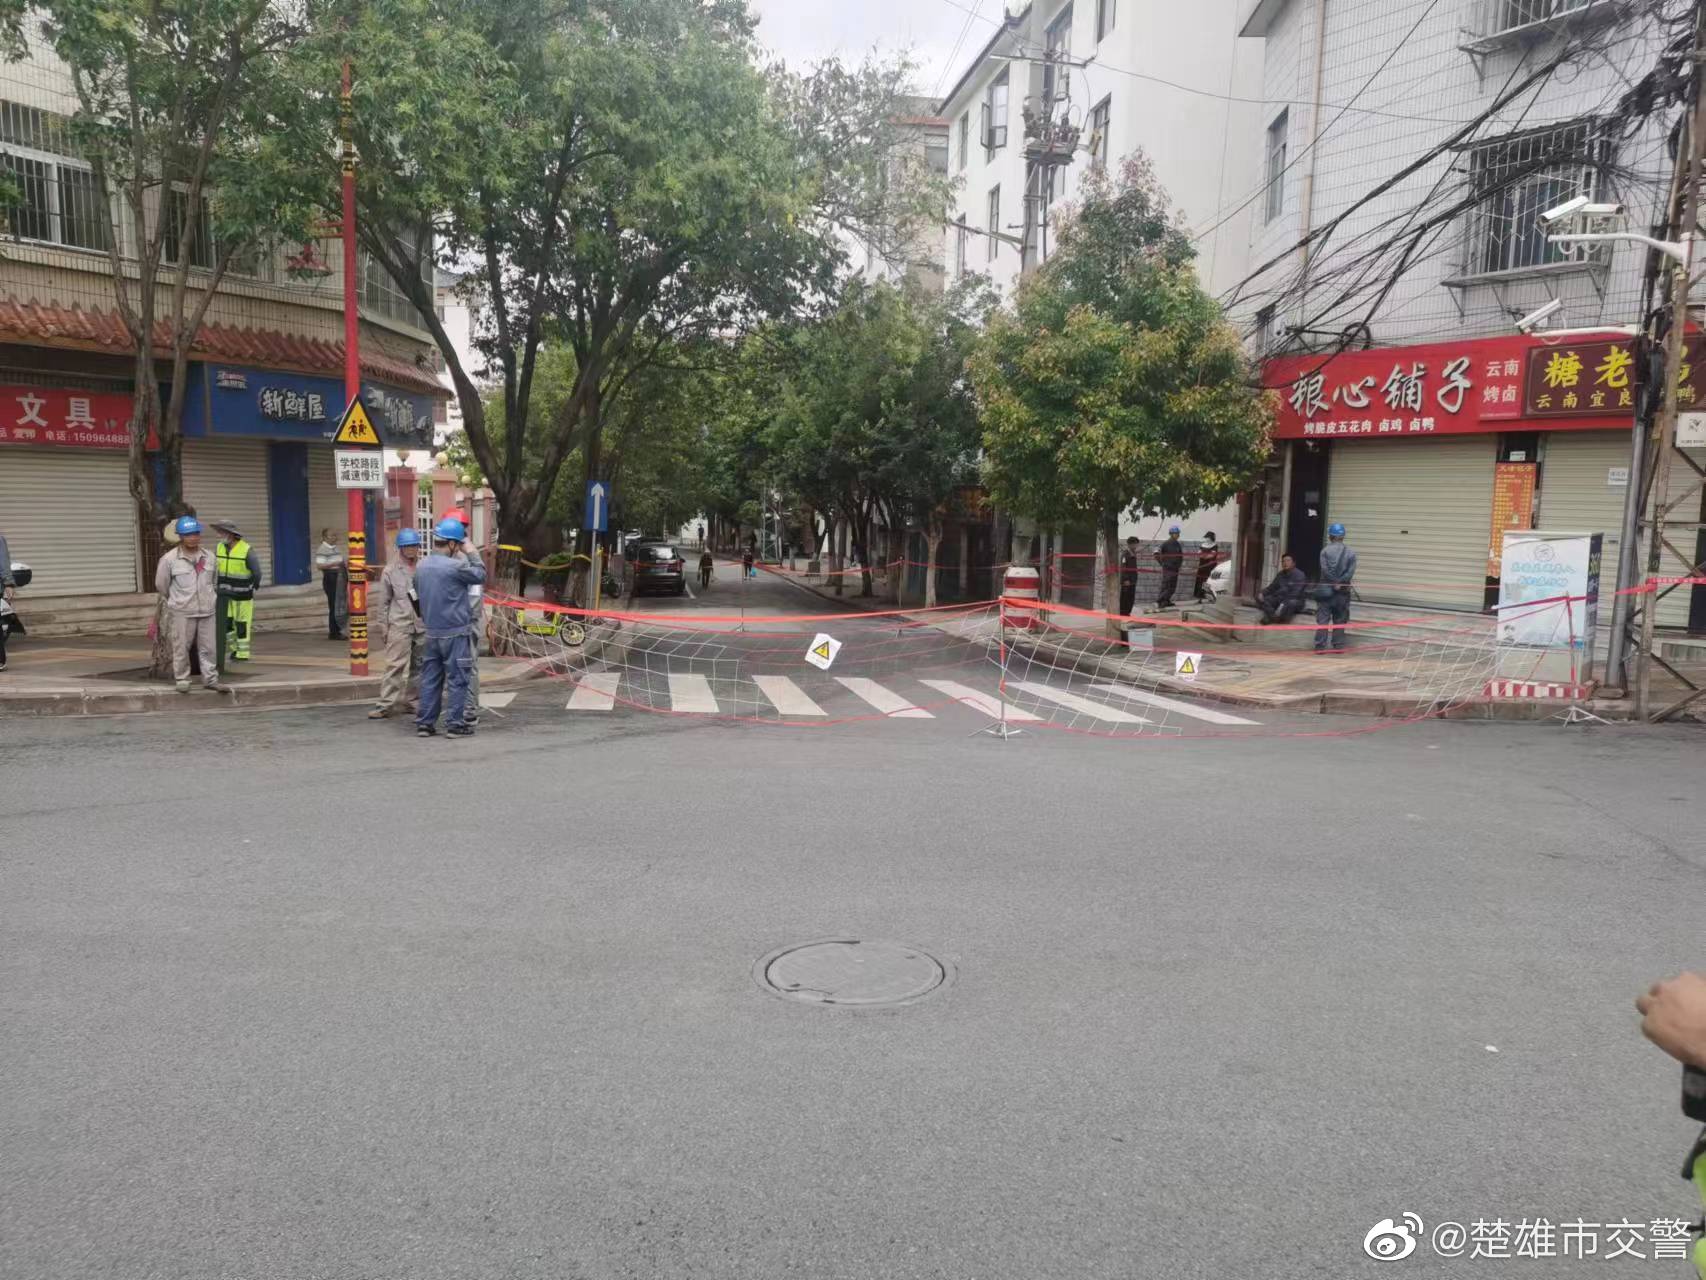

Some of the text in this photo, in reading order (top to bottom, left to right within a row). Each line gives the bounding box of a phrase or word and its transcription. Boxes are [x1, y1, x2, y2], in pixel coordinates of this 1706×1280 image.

[1486, 359, 1521, 378] 云南
[1483, 384, 1517, 404] 烤卤
[1536, 384, 1696, 408] 云南宜良鸭
[15, 392, 97, 431] 文具
[262, 389, 326, 419] 新鲜屋
[1303, 417, 1435, 435] 烤脆皮五花肉 卤鸡 卤鸭
[340, 457, 380, 470] 学校路段
[340, 470, 381, 482] 减速慢行
